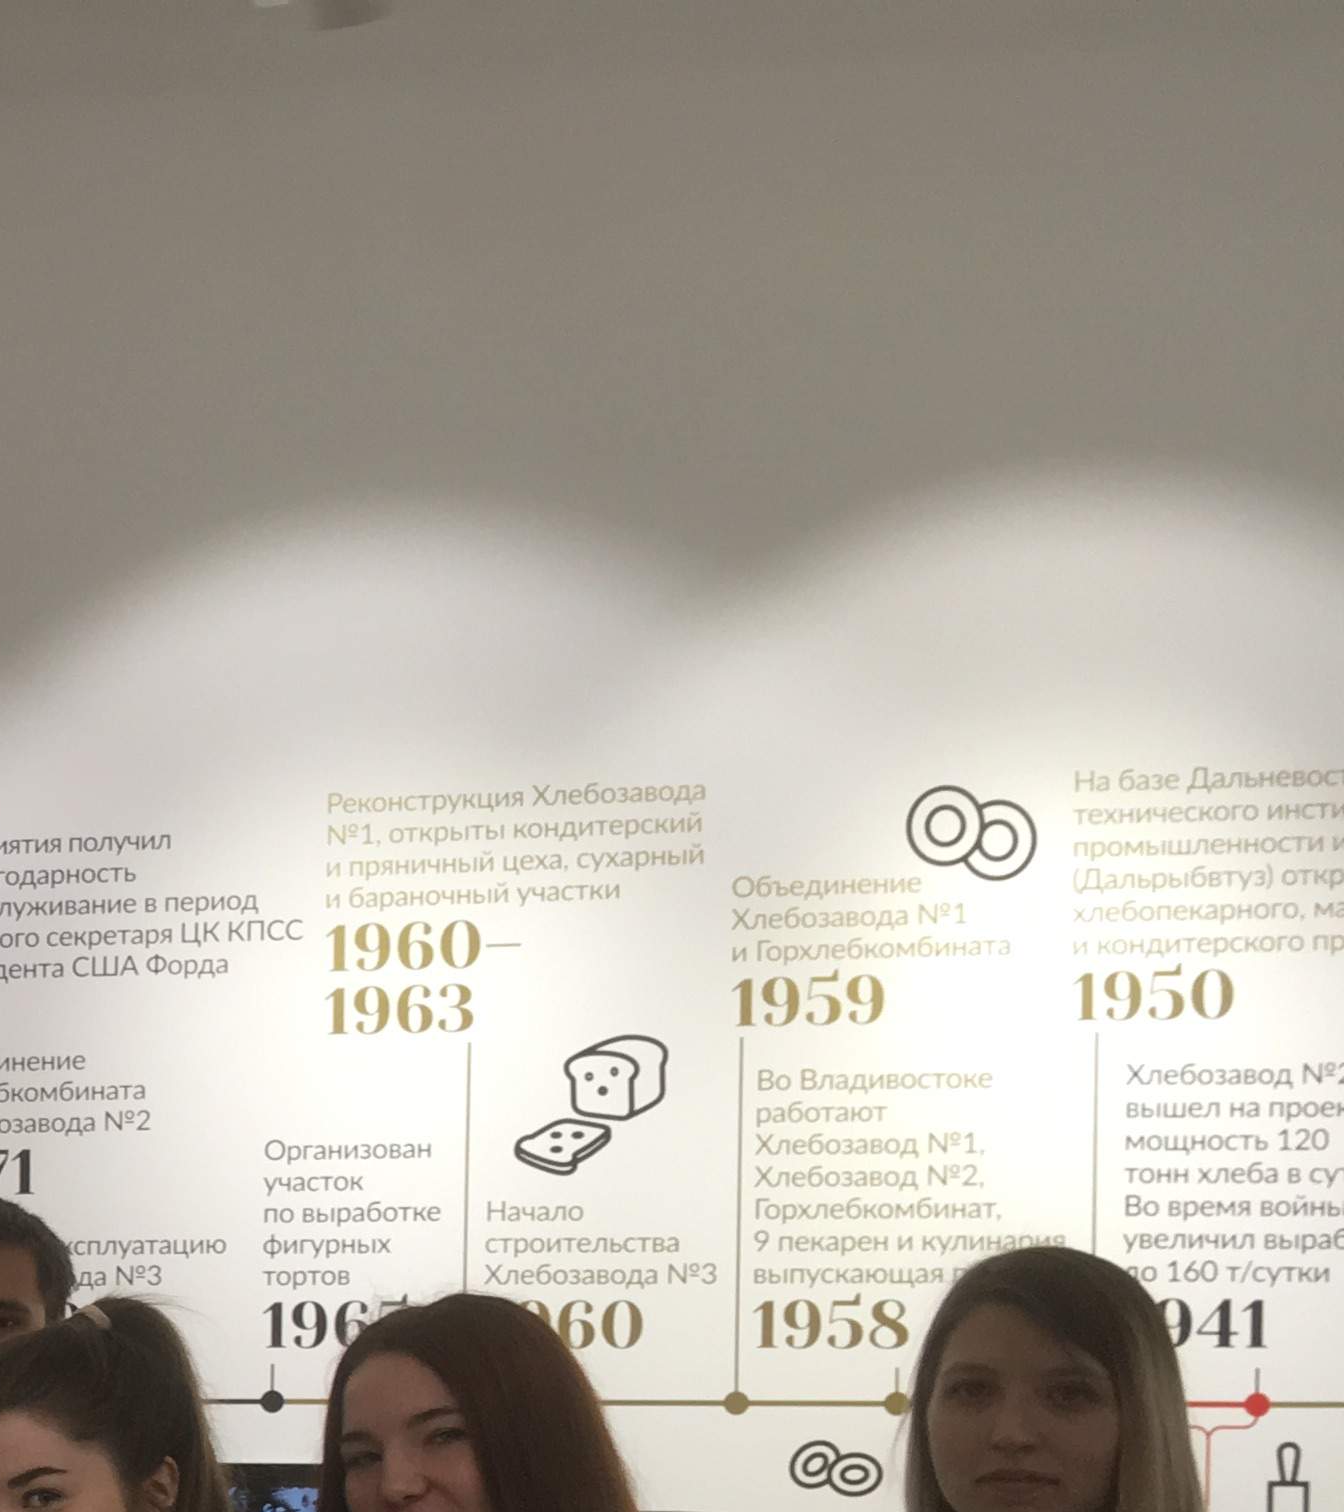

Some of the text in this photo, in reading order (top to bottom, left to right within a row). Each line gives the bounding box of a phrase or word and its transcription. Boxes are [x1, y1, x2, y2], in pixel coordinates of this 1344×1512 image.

[326, 789, 525, 816] Реконструкция
[1072, 803, 1260, 827] технического
[325, 810, 703, 848] №1, открыты кондитерский
[68, 832, 172, 857] получил
[1072, 833, 1329, 863] промышленности
[348, 841, 705, 883] пряничный сухарный
[1072, 860, 1275, 896] (Дальрыбвтуз)
[164, 893, 260, 917] период
[348, 880, 621, 914] бараночный участки
[917, 901, 967, 926] №1
[1073, 898, 1308, 926] хлебопекарного,
[45, 927, 173, 952] секретаря
[227, 917, 304, 944] КПСС
[1096, 933, 1306, 960] кондитерского
[71, 953, 140, 979] США
[145, 952, 229, 980] Форда
[731, 967, 885, 1029] 1959
[1074, 962, 1235, 1022] 1950
[325, 982, 474, 1036] 1963
[799, 1067, 994, 1096] Владивостоке
[104, 1108, 151, 1132] №2
[755, 1099, 889, 1130] работают
[263, 1137, 432, 1166] Организован
[754, 1131, 920, 1160] Хлебозавод
[1124, 1127, 1331, 1157] мощность 120
[262, 1175, 364, 1198] участок
[301, 1200, 442, 1228] выработке
[486, 1200, 585, 1223] Начало
[754, 1195, 1003, 1226] Горхлебкомбинат,
[1167, 1198, 1252, 1222] время
[262, 1233, 392, 1260] фигурных
[484, 1235, 681, 1259] строительства
[777, 1233, 889, 1258] пекарен
[1122, 1231, 1256, 1256] увеличил
[115, 1264, 163, 1287] №3
[261, 1269, 351, 1291] тортов
[667, 1261, 718, 1287] №3
[752, 1266, 945, 1291] выпускающая
[1167, 1258, 1331, 1289] 160 т/сутки
[753, 1291, 910, 1351] 1958
